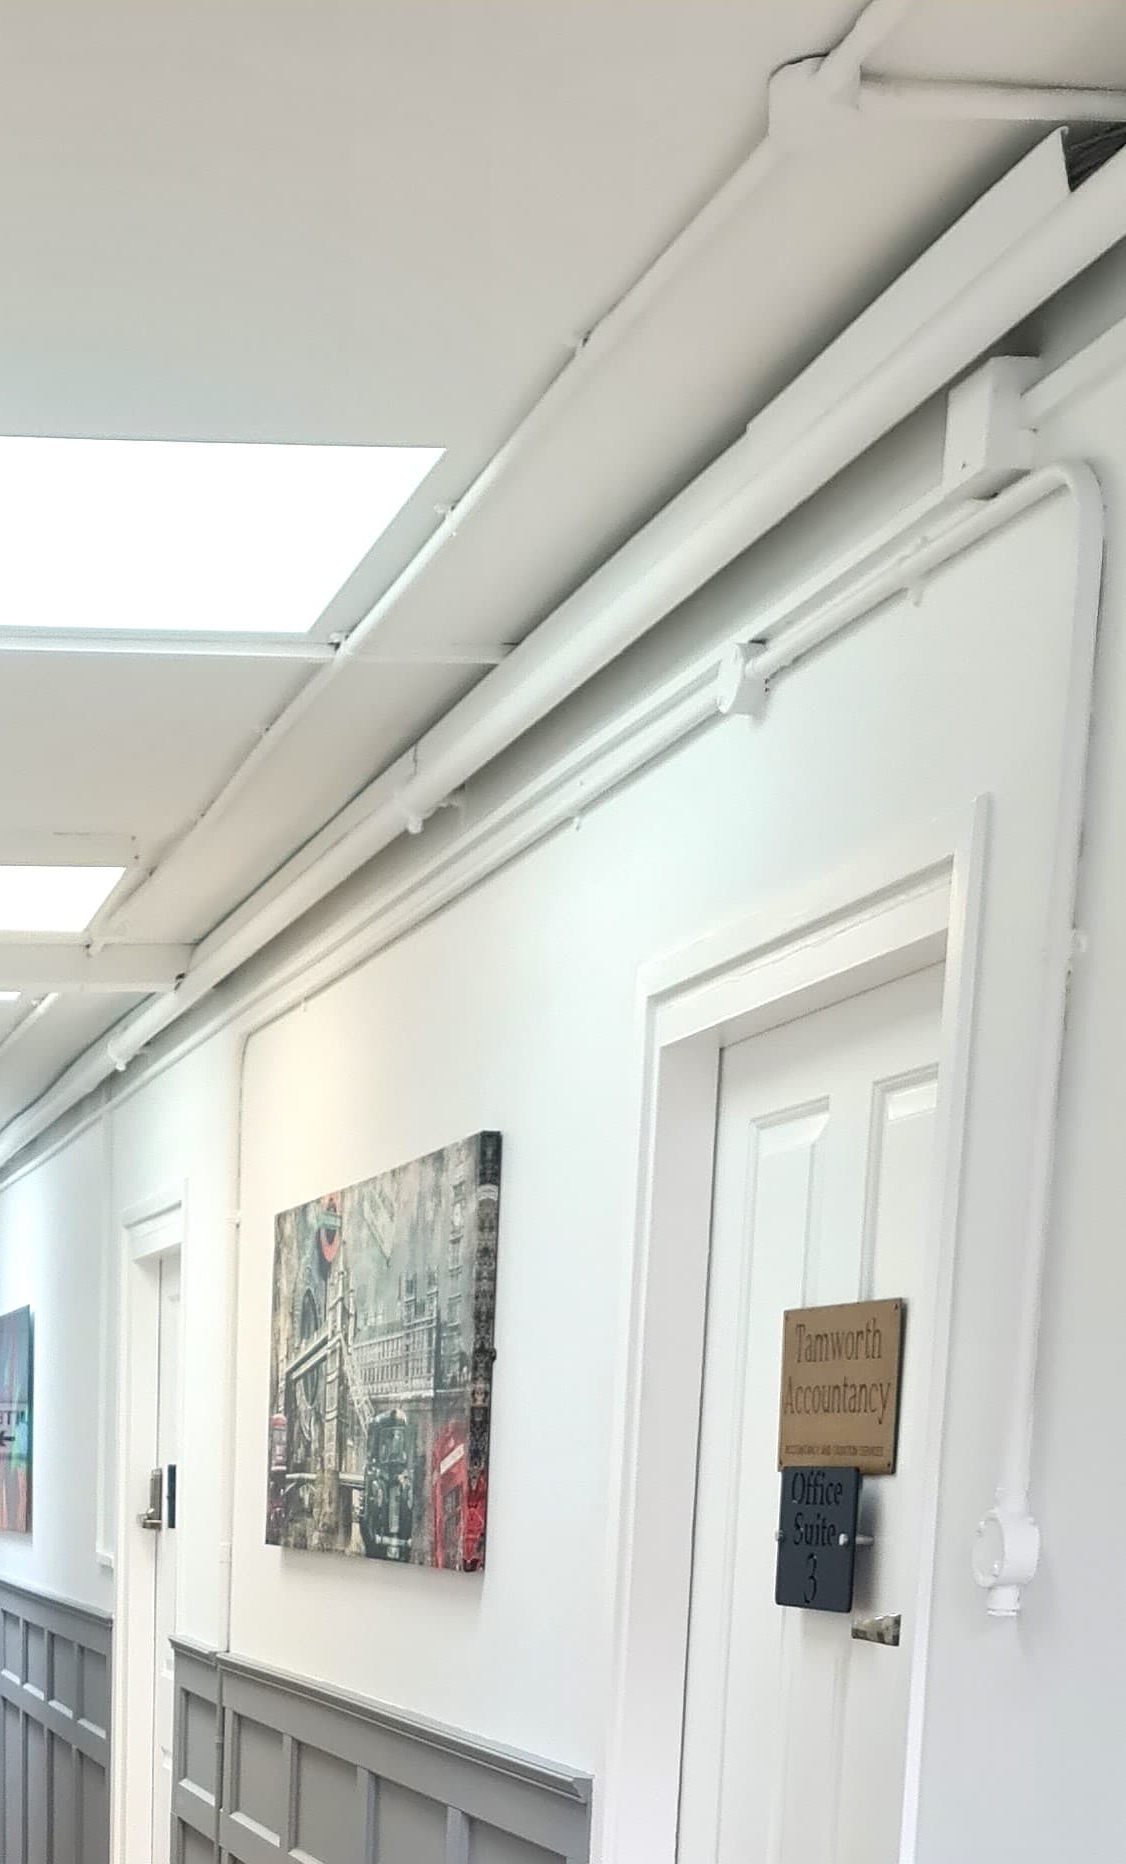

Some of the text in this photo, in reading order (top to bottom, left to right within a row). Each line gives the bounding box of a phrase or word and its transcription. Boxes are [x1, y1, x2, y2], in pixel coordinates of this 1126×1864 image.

[796, 1317, 881, 1363] Tamworth
[783, 1376, 891, 1425] Accountancy
[791, 1470, 843, 1505] Office
[793, 1512, 836, 1546] Suite
[803, 1552, 817, 1604] 3
